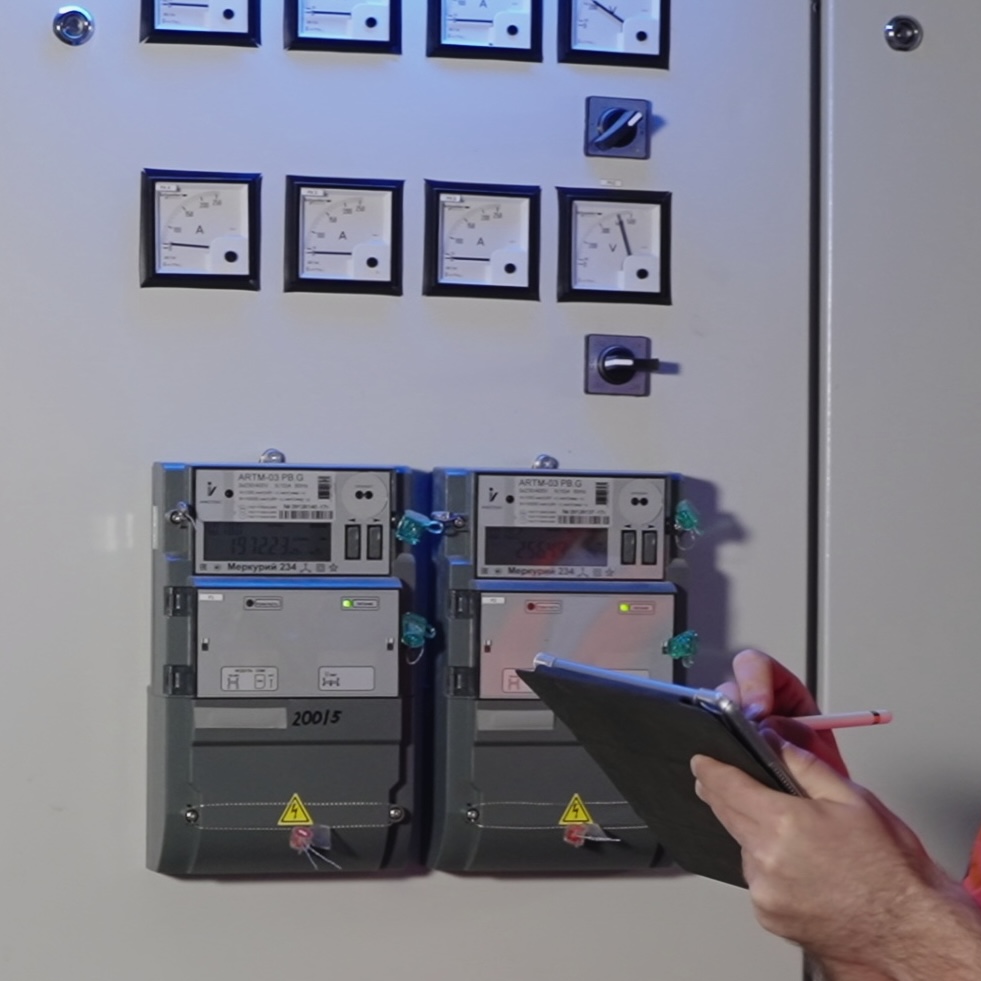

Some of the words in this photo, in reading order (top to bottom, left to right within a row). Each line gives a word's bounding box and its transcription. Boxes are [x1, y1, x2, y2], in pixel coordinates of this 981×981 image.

[195, 225, 204, 234] A
[339, 231, 347, 240] A
[476, 237, 485, 246] A
[608, 244, 617, 253] V
[238, 473, 280, 482] ARTM-03
[518, 479, 559, 488] ARTM-03
[227, 562, 277, 573] Меркурий
[279, 563, 297, 571] 234
[558, 567, 575, 576] 234
